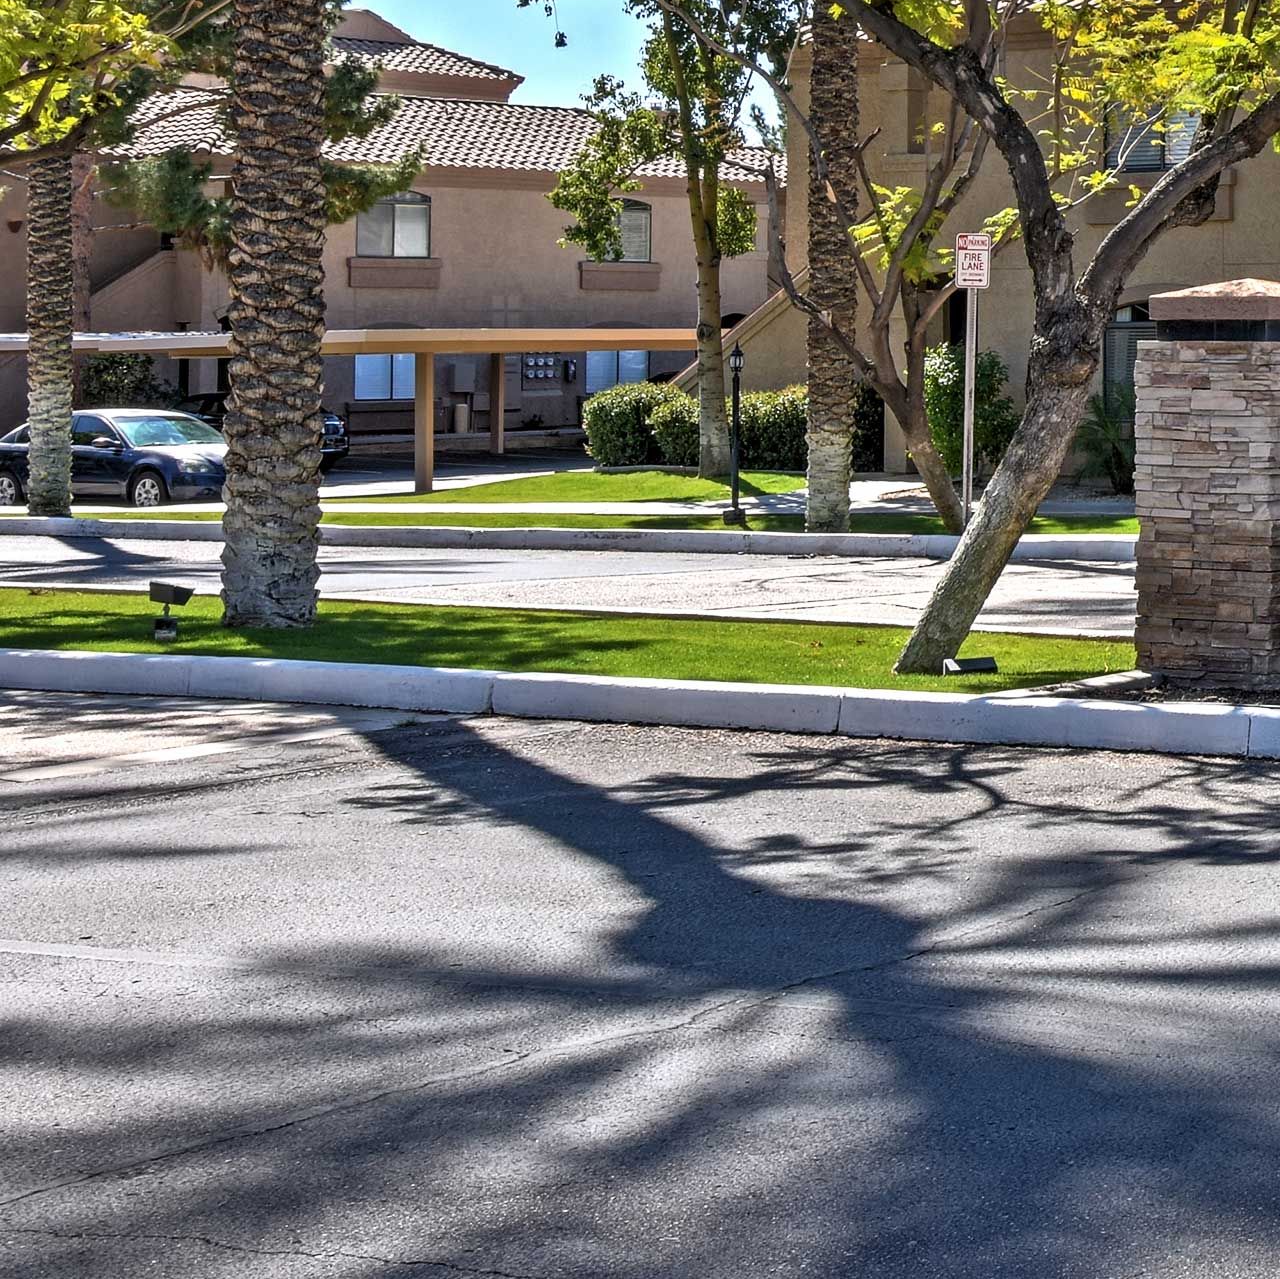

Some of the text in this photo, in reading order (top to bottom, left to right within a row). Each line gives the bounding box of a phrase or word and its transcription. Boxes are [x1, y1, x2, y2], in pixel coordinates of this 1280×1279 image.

[958, 237, 967, 248] NO
[964, 252, 982, 261] FIRE
[961, 262, 984, 271] LANE
